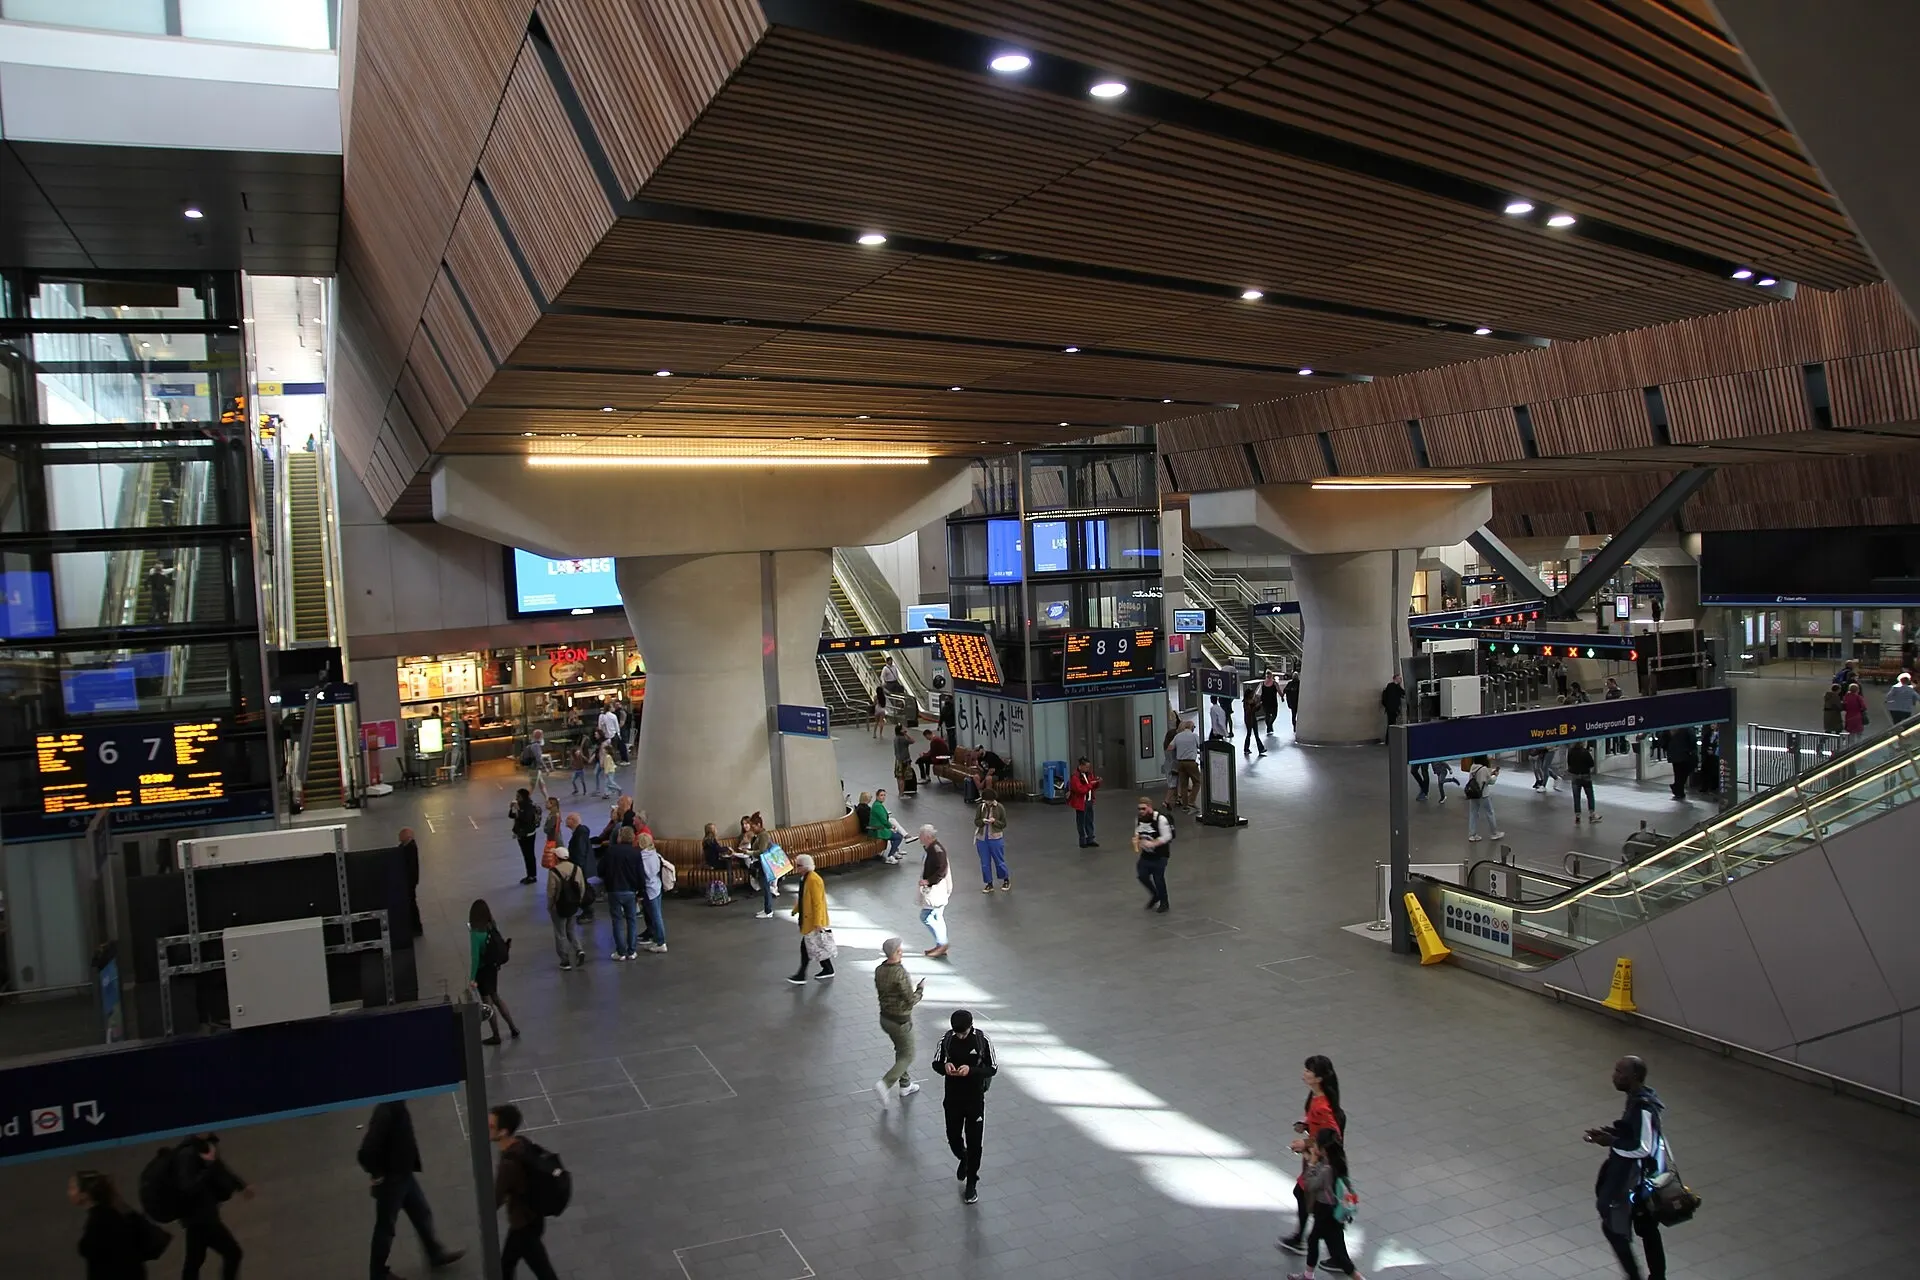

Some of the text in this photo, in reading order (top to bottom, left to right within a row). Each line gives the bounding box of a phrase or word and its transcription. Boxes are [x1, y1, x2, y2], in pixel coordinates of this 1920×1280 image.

[1510, 633, 1536, 641] Underground
[1096, 640, 1106, 655] 8
[1118, 638, 1128, 654] 9
[550, 648, 588, 663] LEON
[1207, 677, 1213, 689] 8
[1217, 678, 1223, 691] 9
[1010, 705, 1024, 721] Lift
[1585, 718, 1626, 731] Underground
[1530, 727, 1557, 739] Way out
[98, 741, 119, 764] 6
[142, 737, 162, 761] 7
[115, 811, 140, 823] Lift
[0, 1116, 19, 1138] d
